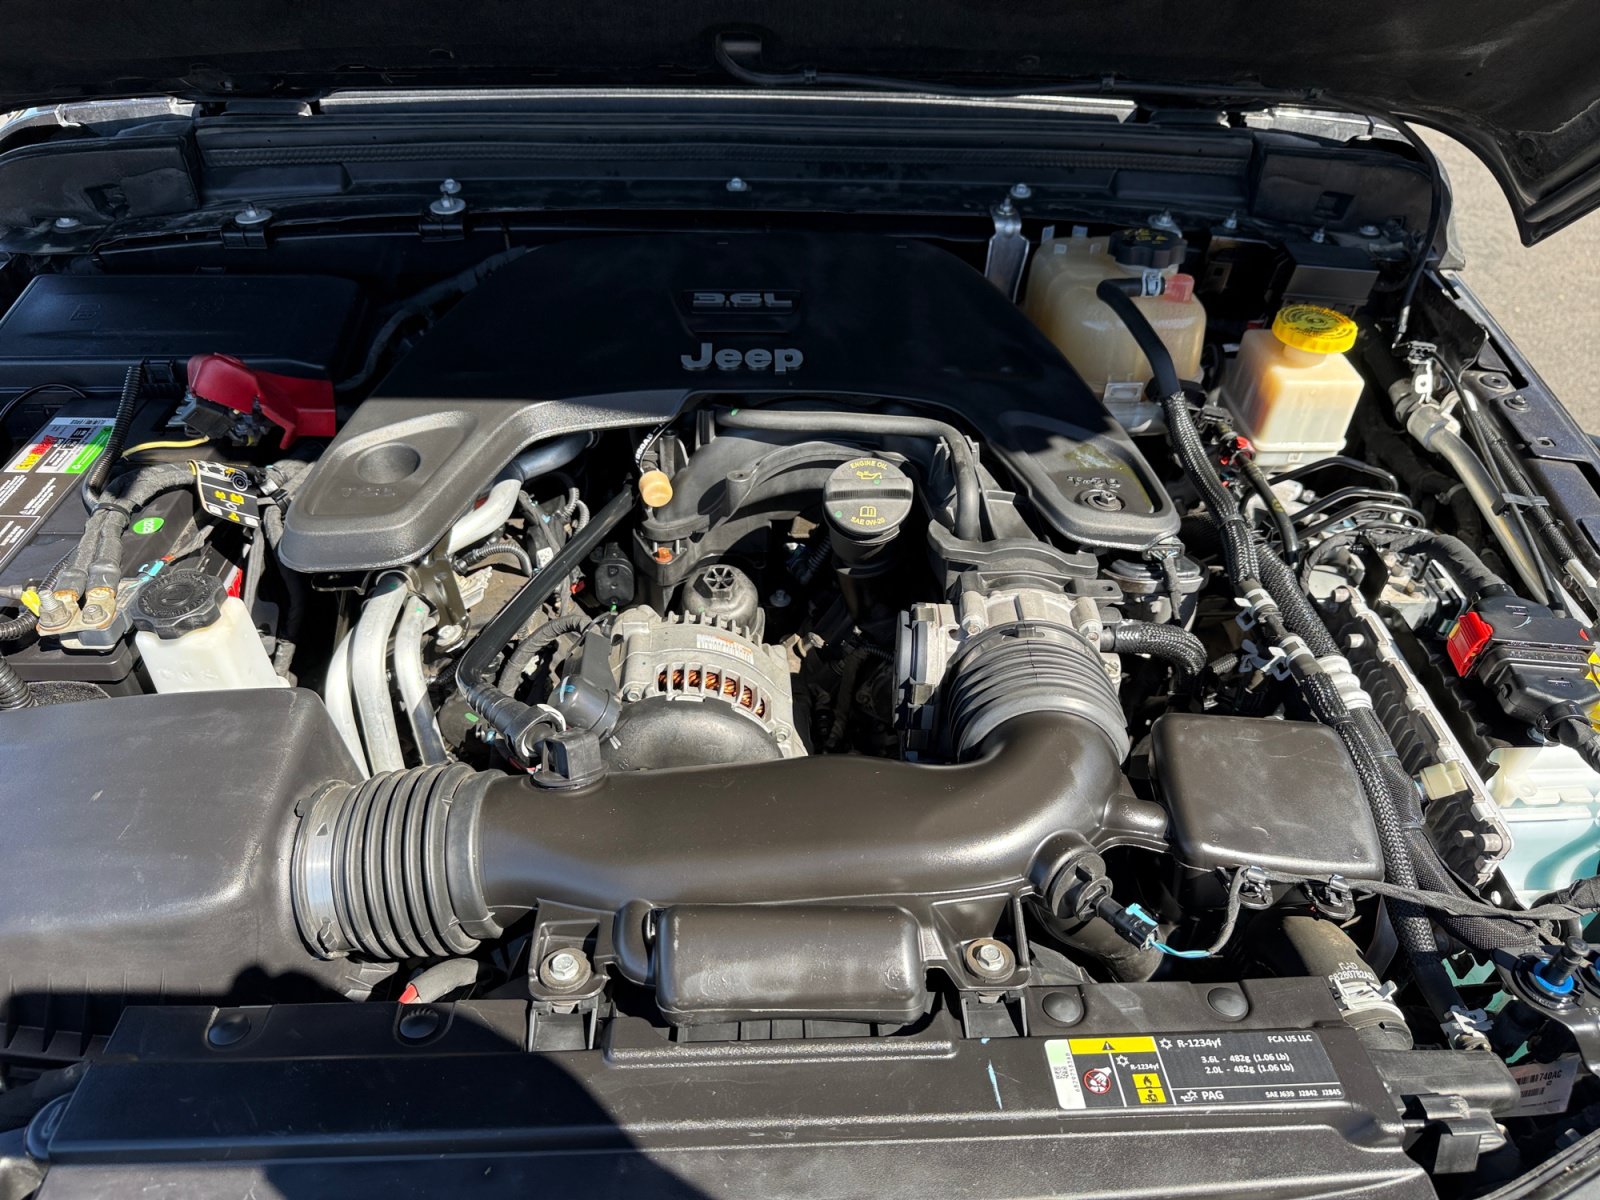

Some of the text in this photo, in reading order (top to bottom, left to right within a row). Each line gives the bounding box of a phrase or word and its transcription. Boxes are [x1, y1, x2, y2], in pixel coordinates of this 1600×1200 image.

[692, 292, 793, 308] 3.6L
[680, 342, 804, 376] Jeep
[850, 460, 888, 470] ENGINE OIL
[850, 516, 865, 526] SAE
[1177, 1037, 1223, 1049] R-1234yf
[1267, 1034, 1313, 1044] FCA US LLC
[1200, 1054, 1220, 1064] 3.6L
[1229, 1054, 1251, 1064] 482g
[1253, 1053, 1277, 1063] (1.06
[1277, 1052, 1290, 1063] Lb)
[1129, 1062, 1160, 1071] R-1234yf
[1205, 1066, 1224, 1075] 2.0L
[1233, 1065, 1256, 1075] 482g
[1257, 1064, 1281, 1074] (1.06
[1281, 1063, 1295, 1073] Lb)
[1201, 1090, 1224, 1101] PAG
[1265, 1090, 1279, 1099] SAE
